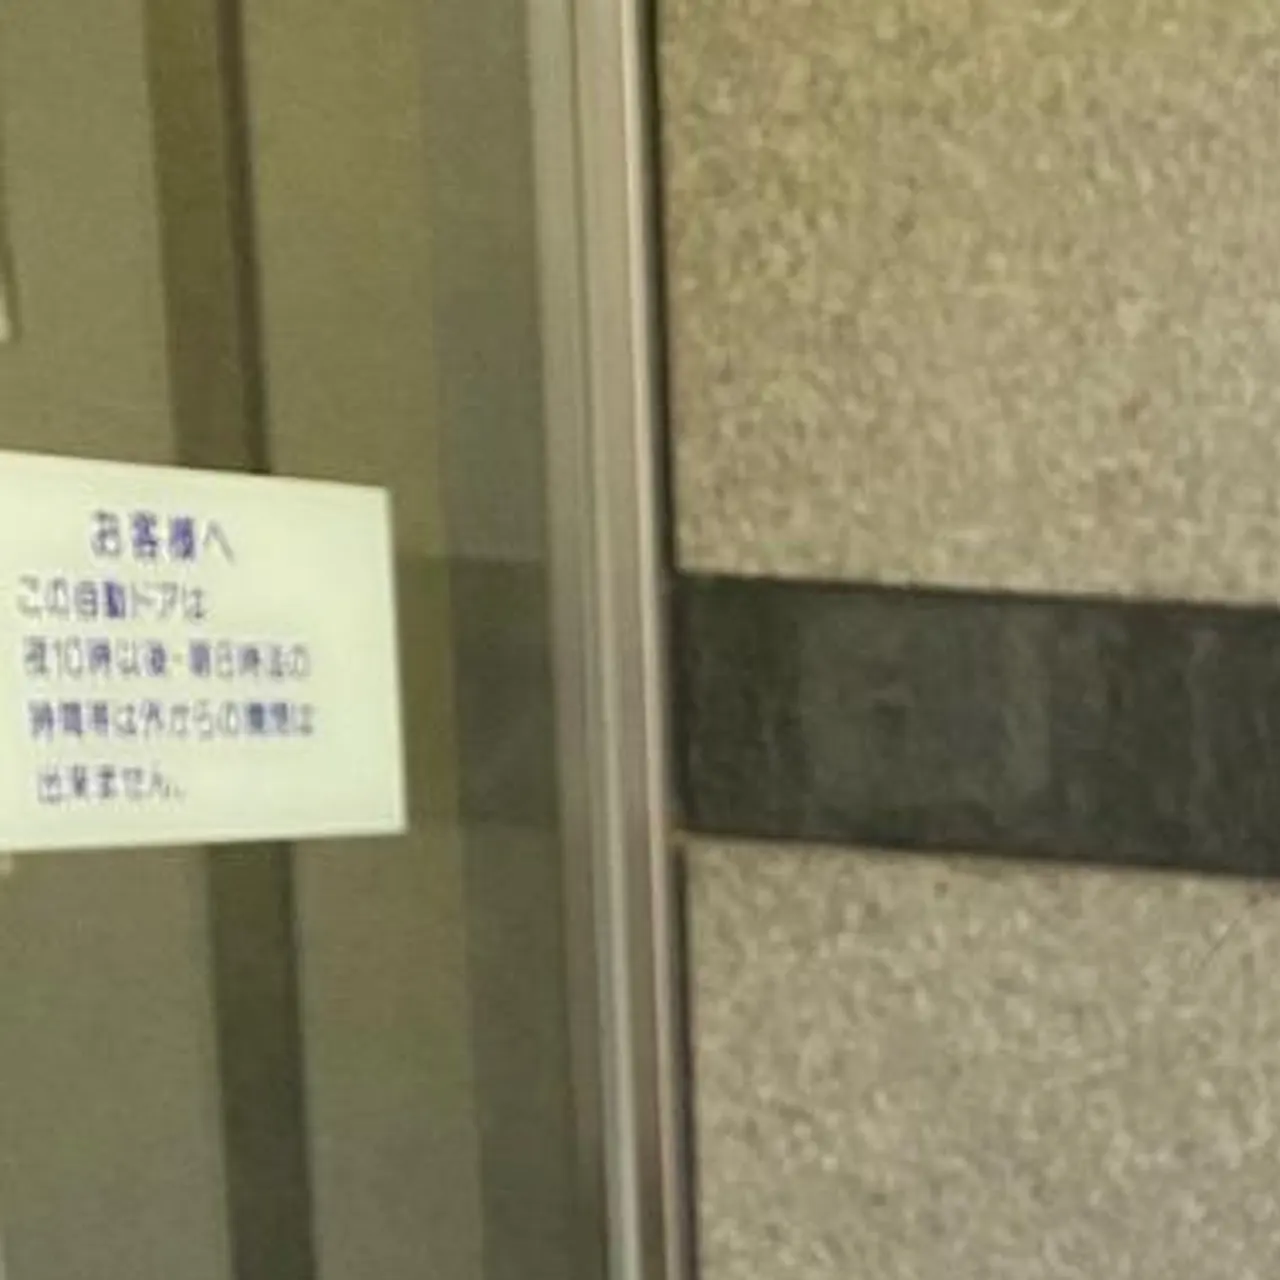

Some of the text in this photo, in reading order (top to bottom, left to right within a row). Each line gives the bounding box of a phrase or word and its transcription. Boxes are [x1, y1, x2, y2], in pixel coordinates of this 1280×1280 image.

[89, 509, 236, 565] お客様へ
[17, 575, 209, 619] この自動ドアは
